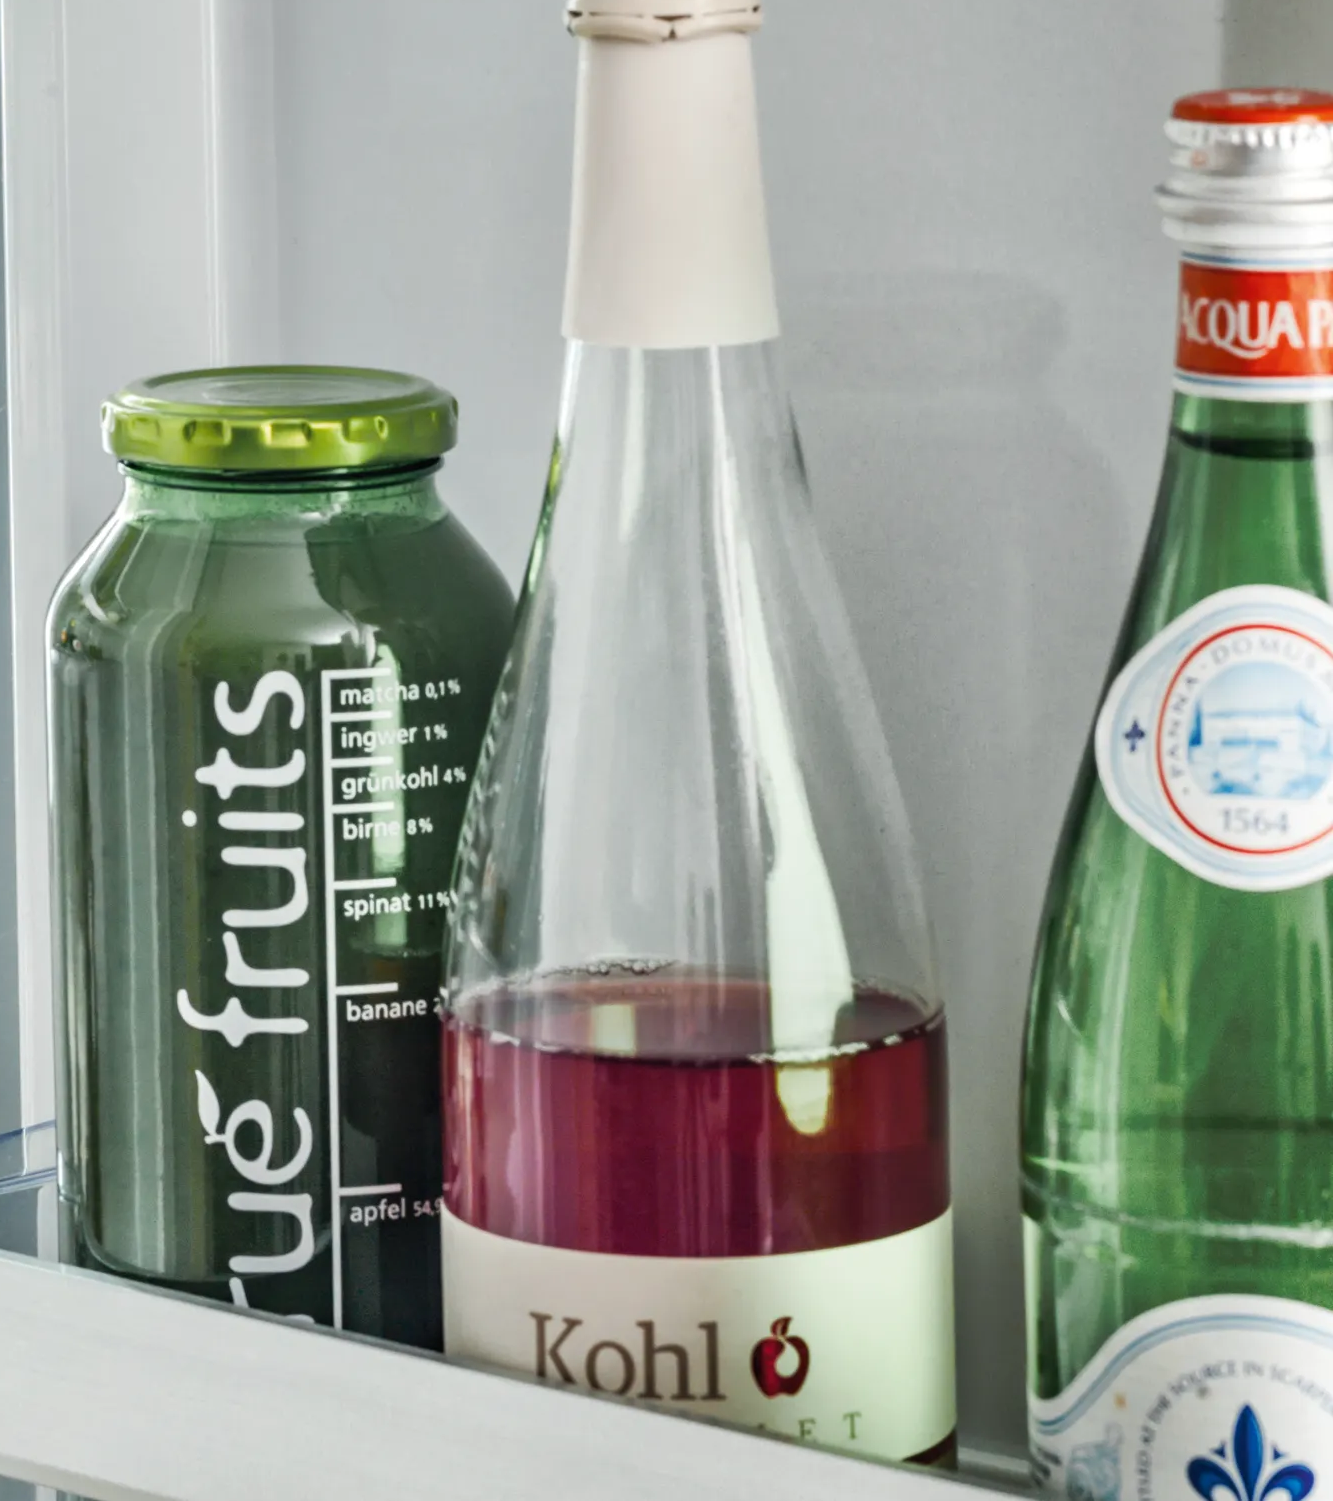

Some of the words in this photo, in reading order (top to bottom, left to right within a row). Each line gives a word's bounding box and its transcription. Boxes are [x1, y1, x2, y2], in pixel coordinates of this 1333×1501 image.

[339, 683, 420, 706] matcha
[425, 678, 461, 700] 0,1%
[340, 727, 417, 752] ingwer
[423, 724, 449, 741] 1%
[340, 765, 439, 800] grünkohl
[443, 766, 467, 784] 4%
[342, 817, 401, 841] birne
[406, 817, 434, 835] 8%
[177, 669, 311, 1048] fruits
[343, 891, 412, 921] spinat
[346, 998, 427, 1022] banane
[349, 1197, 406, 1227] apfel
[529, 1310, 728, 1402] Kohl
